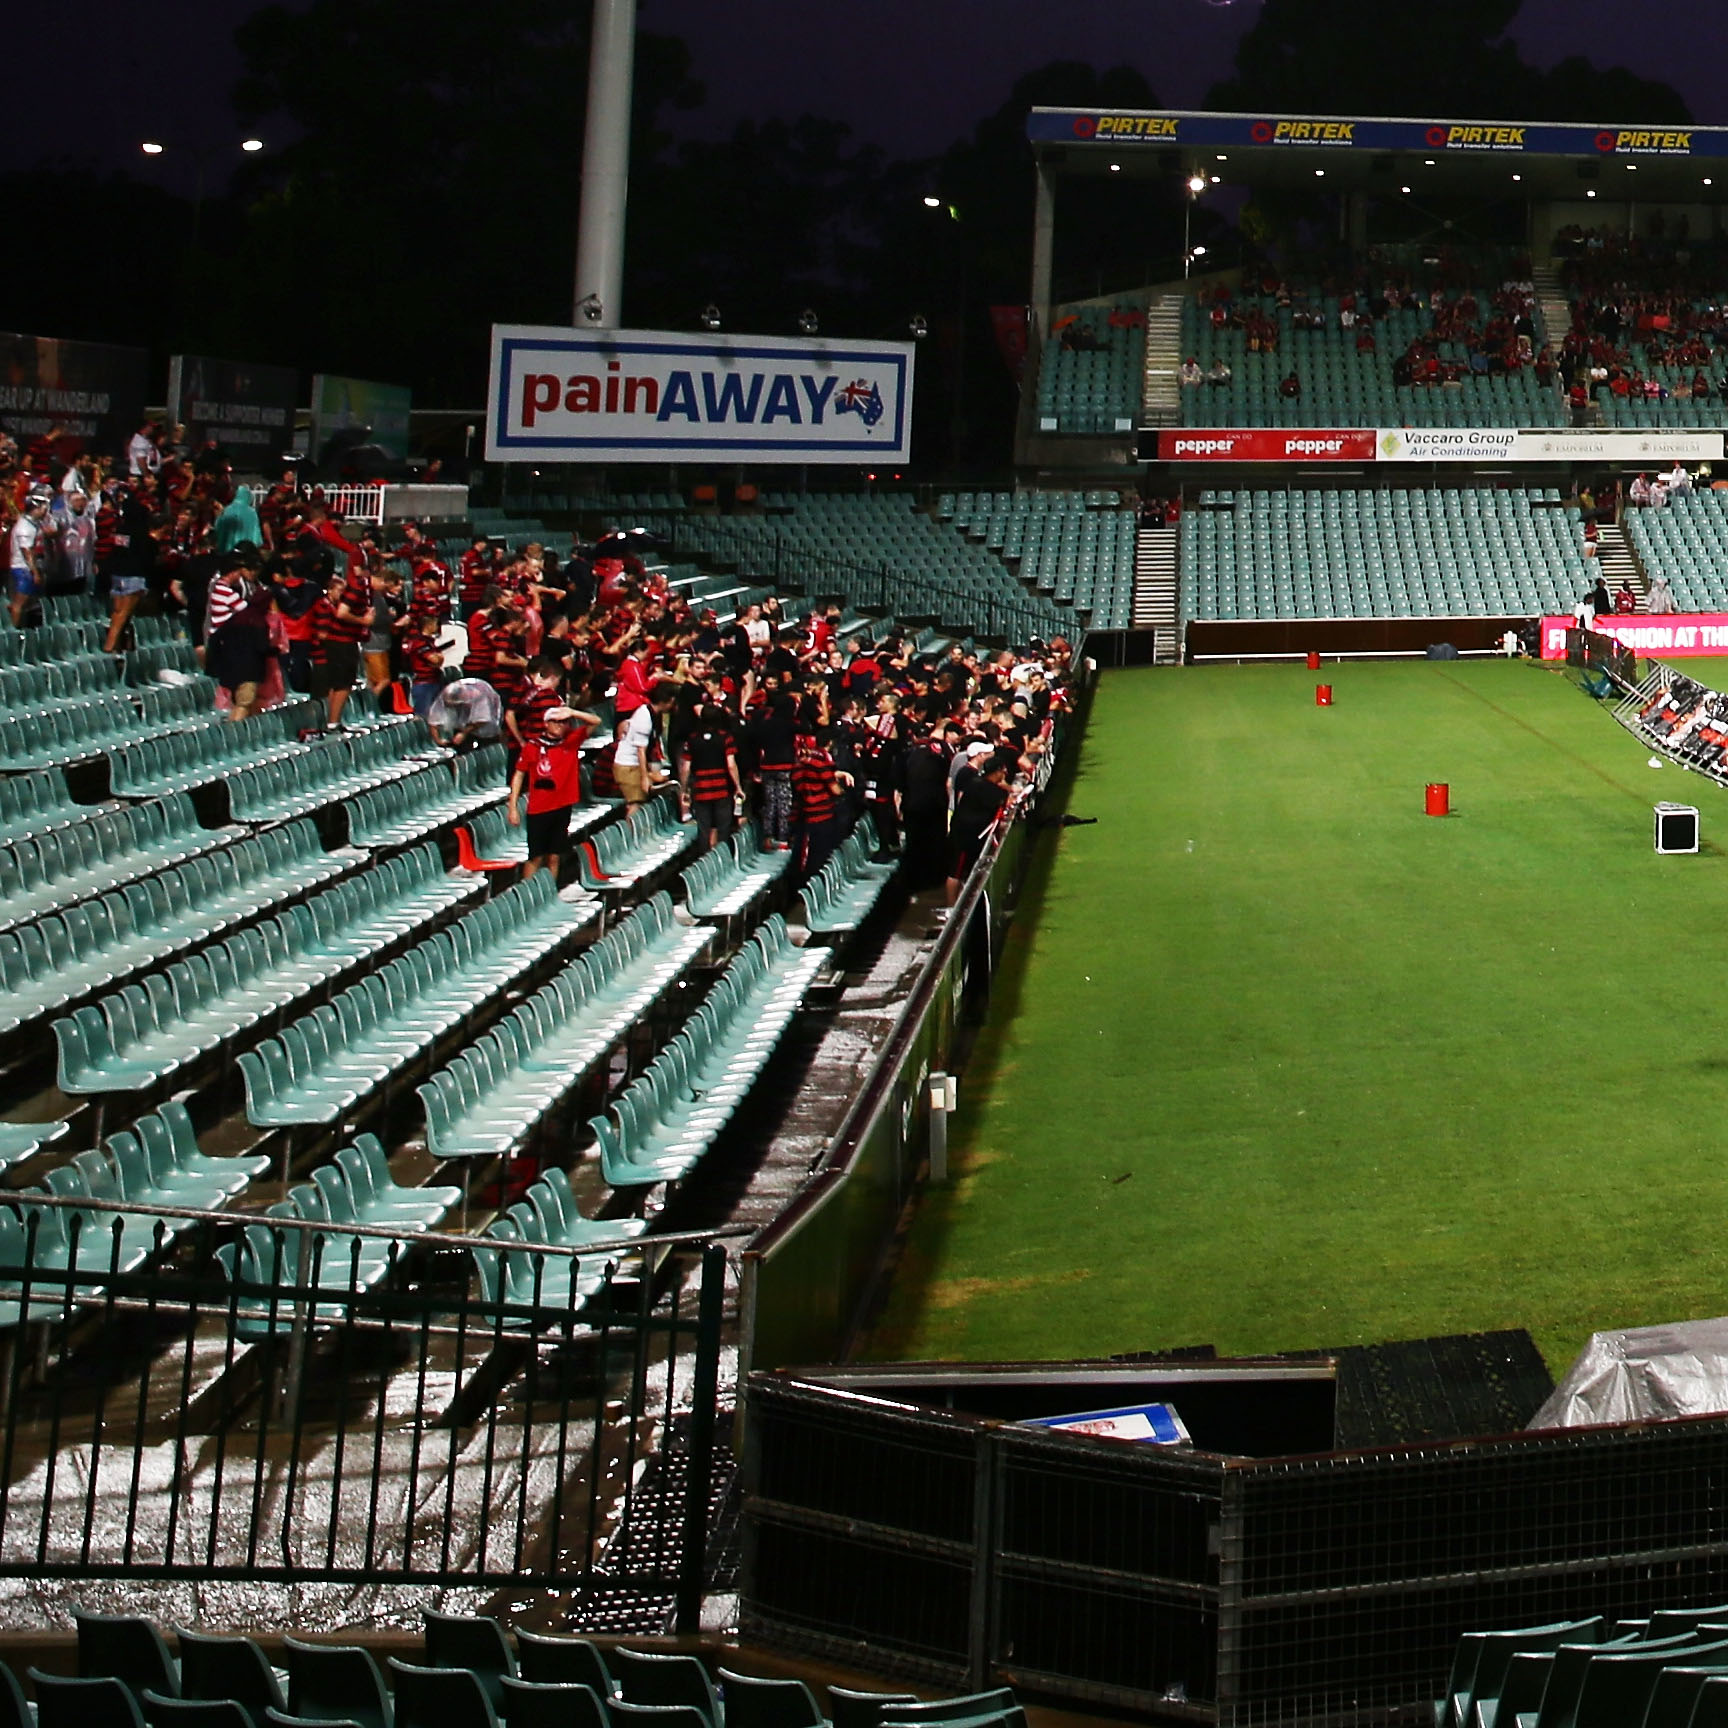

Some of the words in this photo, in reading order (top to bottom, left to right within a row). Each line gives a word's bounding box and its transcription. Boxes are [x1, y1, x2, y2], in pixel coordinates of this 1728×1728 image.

[1099, 118, 1178, 135] PIRTEK
[1276, 123, 1354, 139] PIRTEK
[1449, 127, 1525, 144] PIRTEK
[1618, 133, 1691, 148] PIRTEK
[521, 362, 840, 427] painAWAY
[1175, 438, 1234, 454] pepper
[1285, 438, 1343, 454] pepper
[1404, 432, 1464, 445] Vaccaro
[1466, 432, 1514, 447] Group
[1410, 446, 1427, 457] Air
[1429, 446, 1507, 459] Conditioning
[1675, 627, 1698, 648] AT
